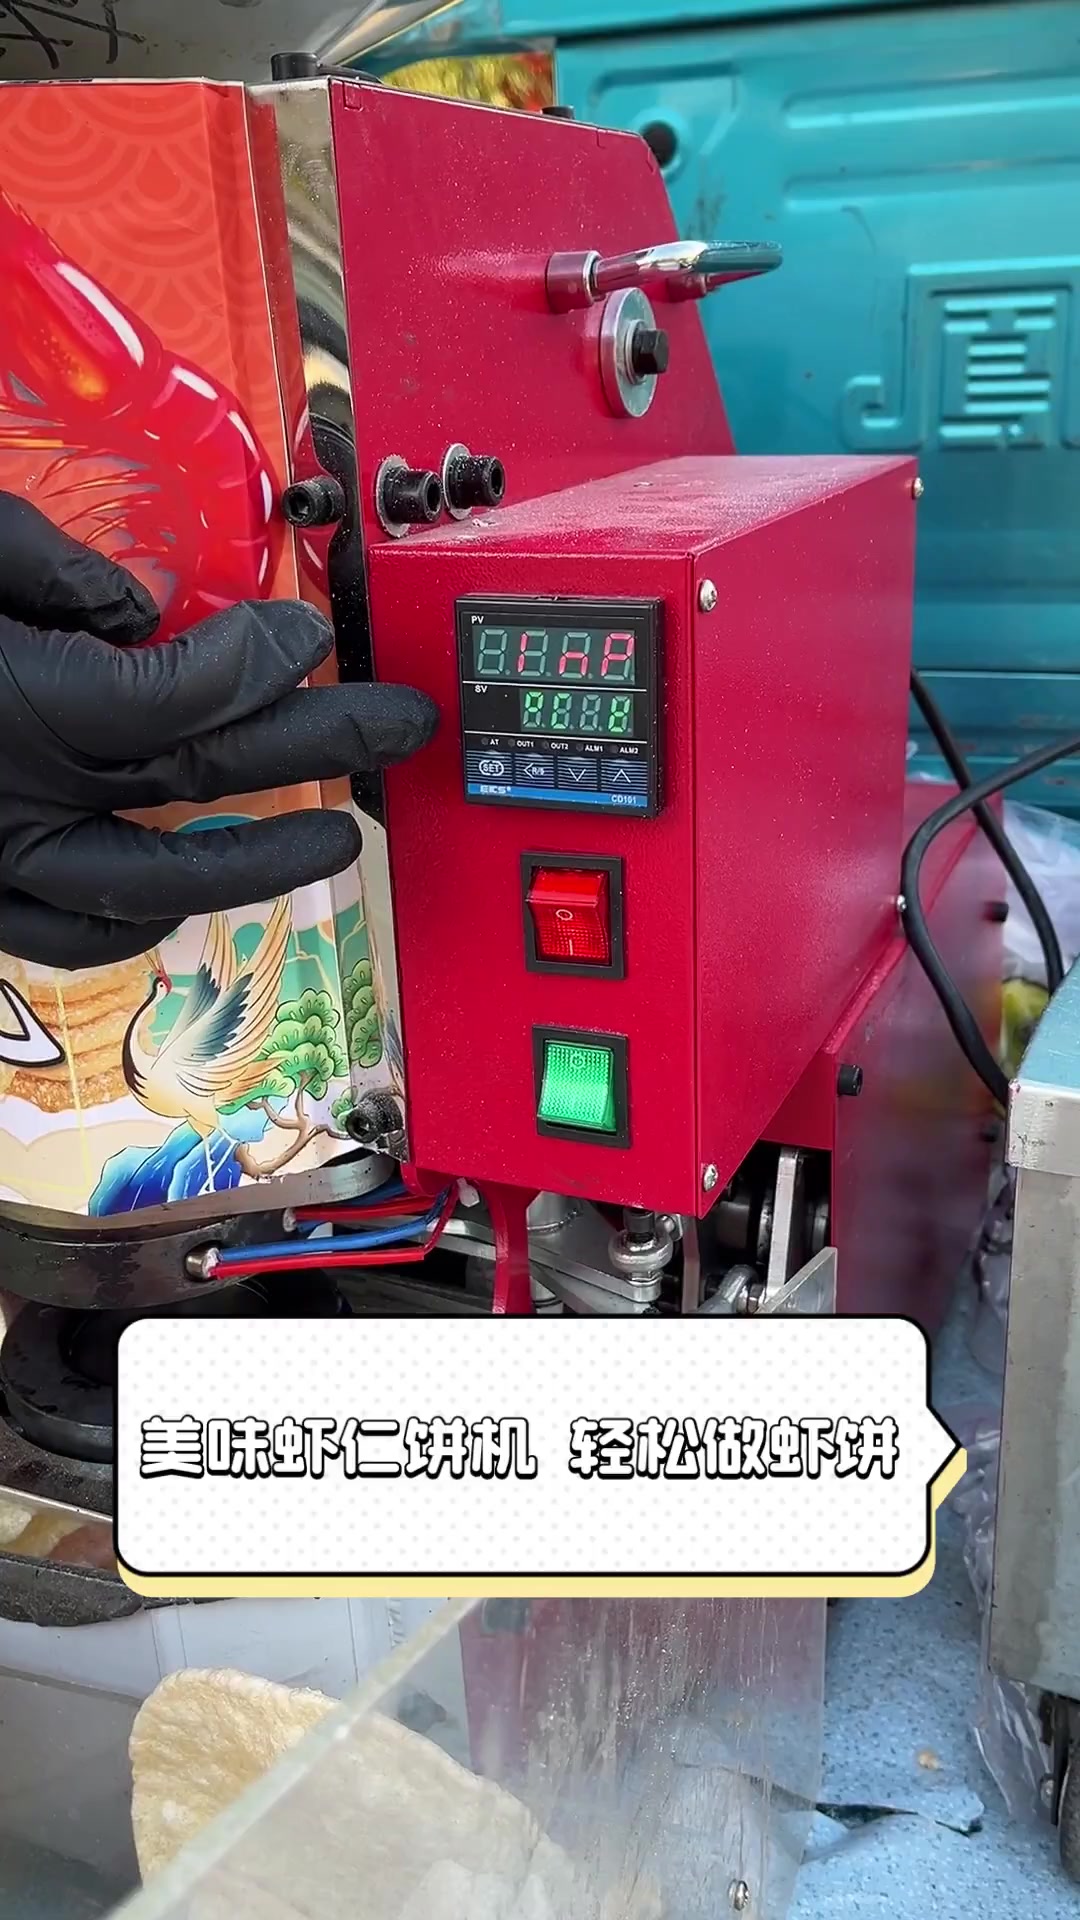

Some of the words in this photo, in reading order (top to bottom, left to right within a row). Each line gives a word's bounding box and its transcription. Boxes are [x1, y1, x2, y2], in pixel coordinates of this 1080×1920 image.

[471, 616, 484, 624] PV
[585, 744, 603, 752] ALM1
[620, 746, 639, 754] ALM2
[482, 763, 499, 773] SET
[611, 795, 637, 804] CD101
